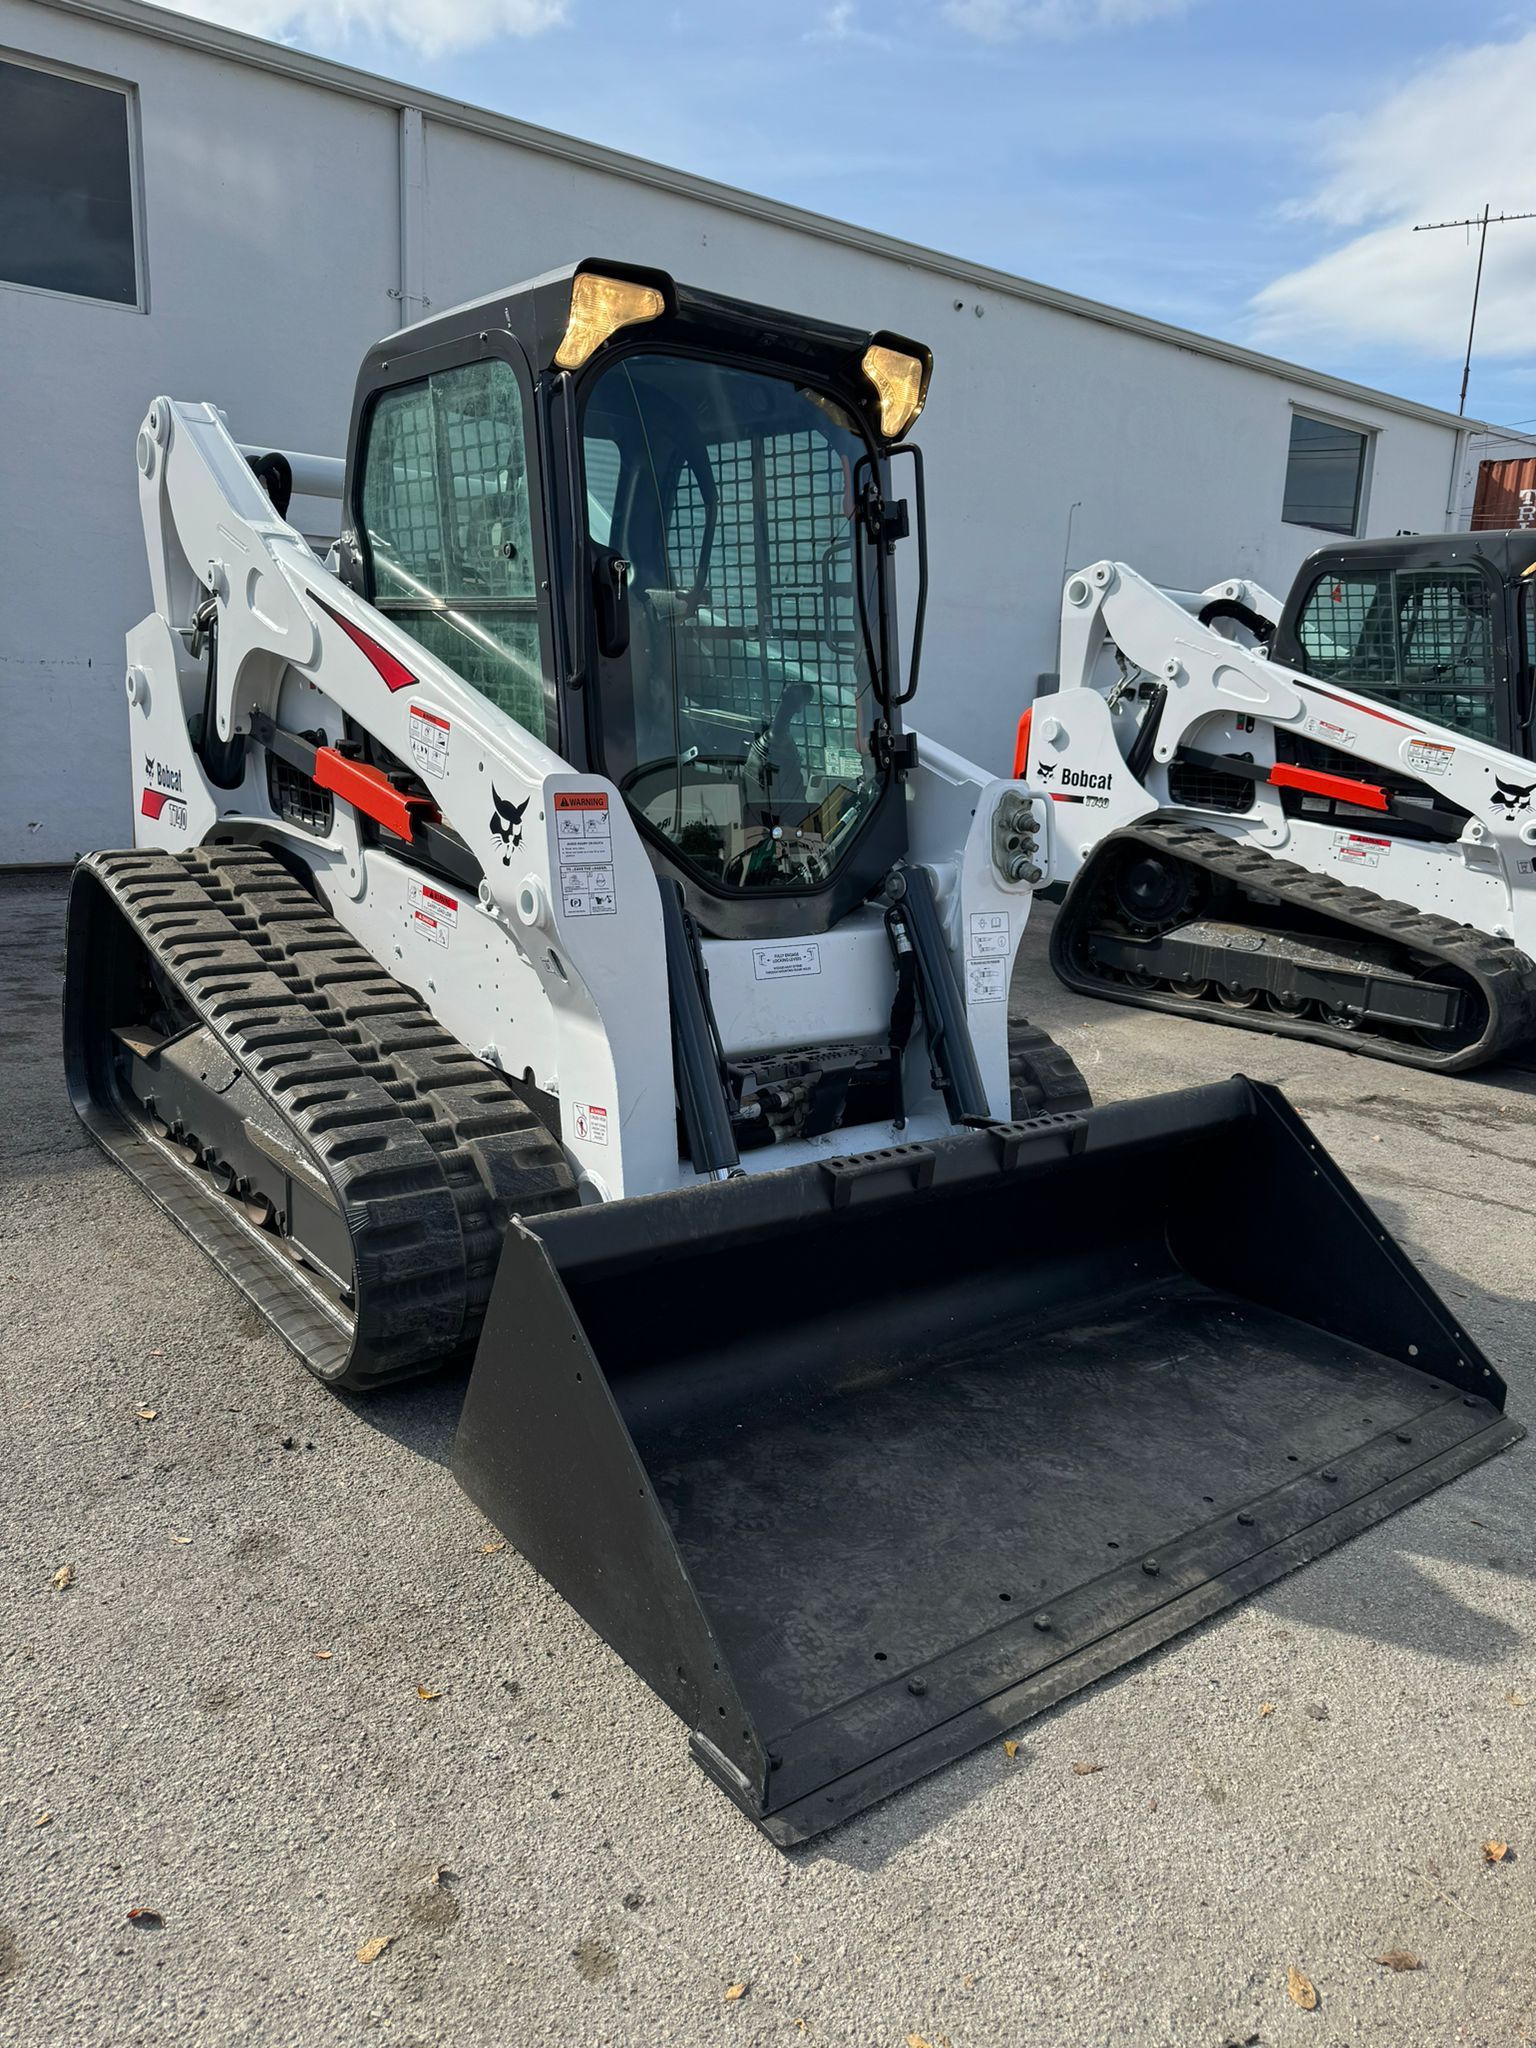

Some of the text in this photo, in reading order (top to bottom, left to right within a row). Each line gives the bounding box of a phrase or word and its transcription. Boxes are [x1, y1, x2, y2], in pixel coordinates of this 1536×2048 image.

[157, 762, 183, 793] Bobcat
[1061, 767, 1113, 791] Bobcat
[569, 797, 604, 807] WARNING
